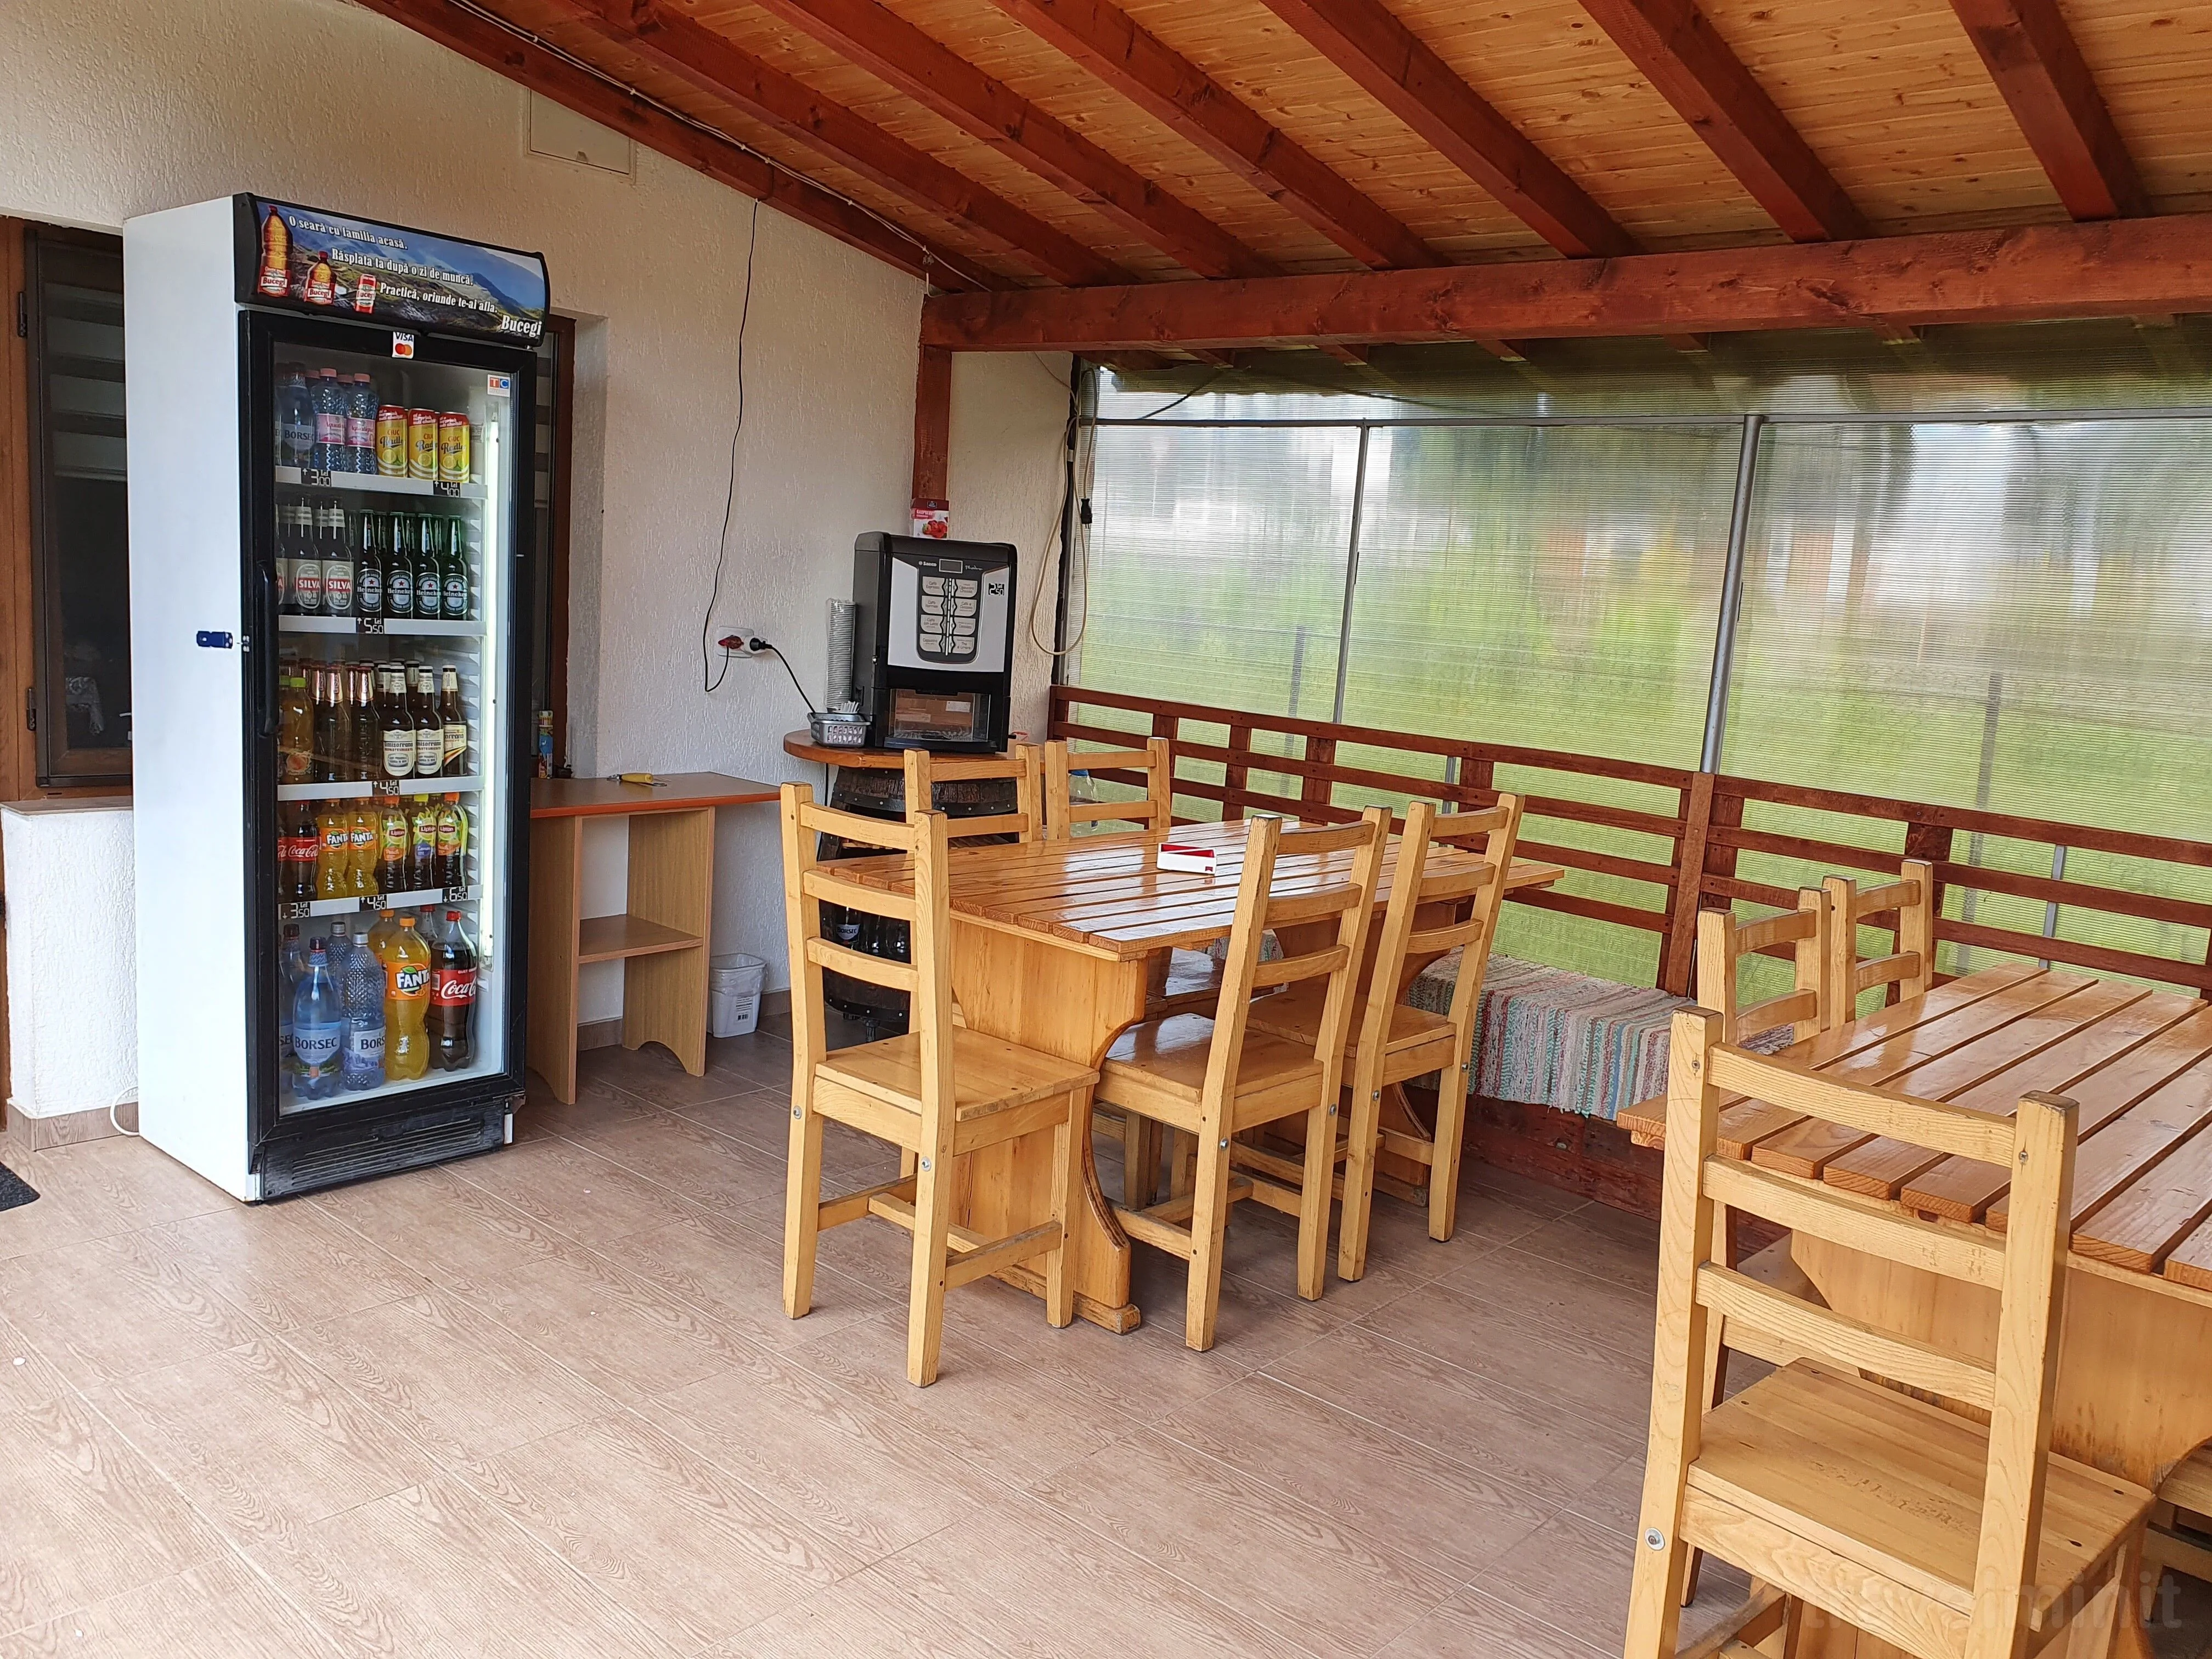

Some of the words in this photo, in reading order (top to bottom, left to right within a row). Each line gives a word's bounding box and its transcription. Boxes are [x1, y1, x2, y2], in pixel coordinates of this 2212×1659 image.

[289, 216, 296, 226] O
[299, 220, 326, 233] seară
[329, 225, 340, 236] cu
[342, 227, 376, 243] familia
[379, 236, 408, 249] acasă.
[331, 248, 373, 265] Răsplata
[375, 257, 384, 269] ta
[387, 259, 409, 274] după
[412, 267, 417, 275] o
[420, 266, 427, 277] zi
[430, 267, 440, 279] de
[263, 277, 285, 286] Bucegi
[380, 283, 419, 301] Practică,
[422, 291, 456, 306] oriunde
[459, 297, 477, 309] te-ai
[479, 301, 497, 313] afla.
[501, 315, 542, 337] Bucegi
[395, 332, 413, 342] VISA
[299, 580, 320, 588] SILVA
[329, 581, 351, 590] SILVA
[351, 832, 374, 843] FANTA
[396, 969, 430, 989] FANTA
[295, 1036, 337, 1049] BORSEC
[360, 1035, 385, 1050] BORS
